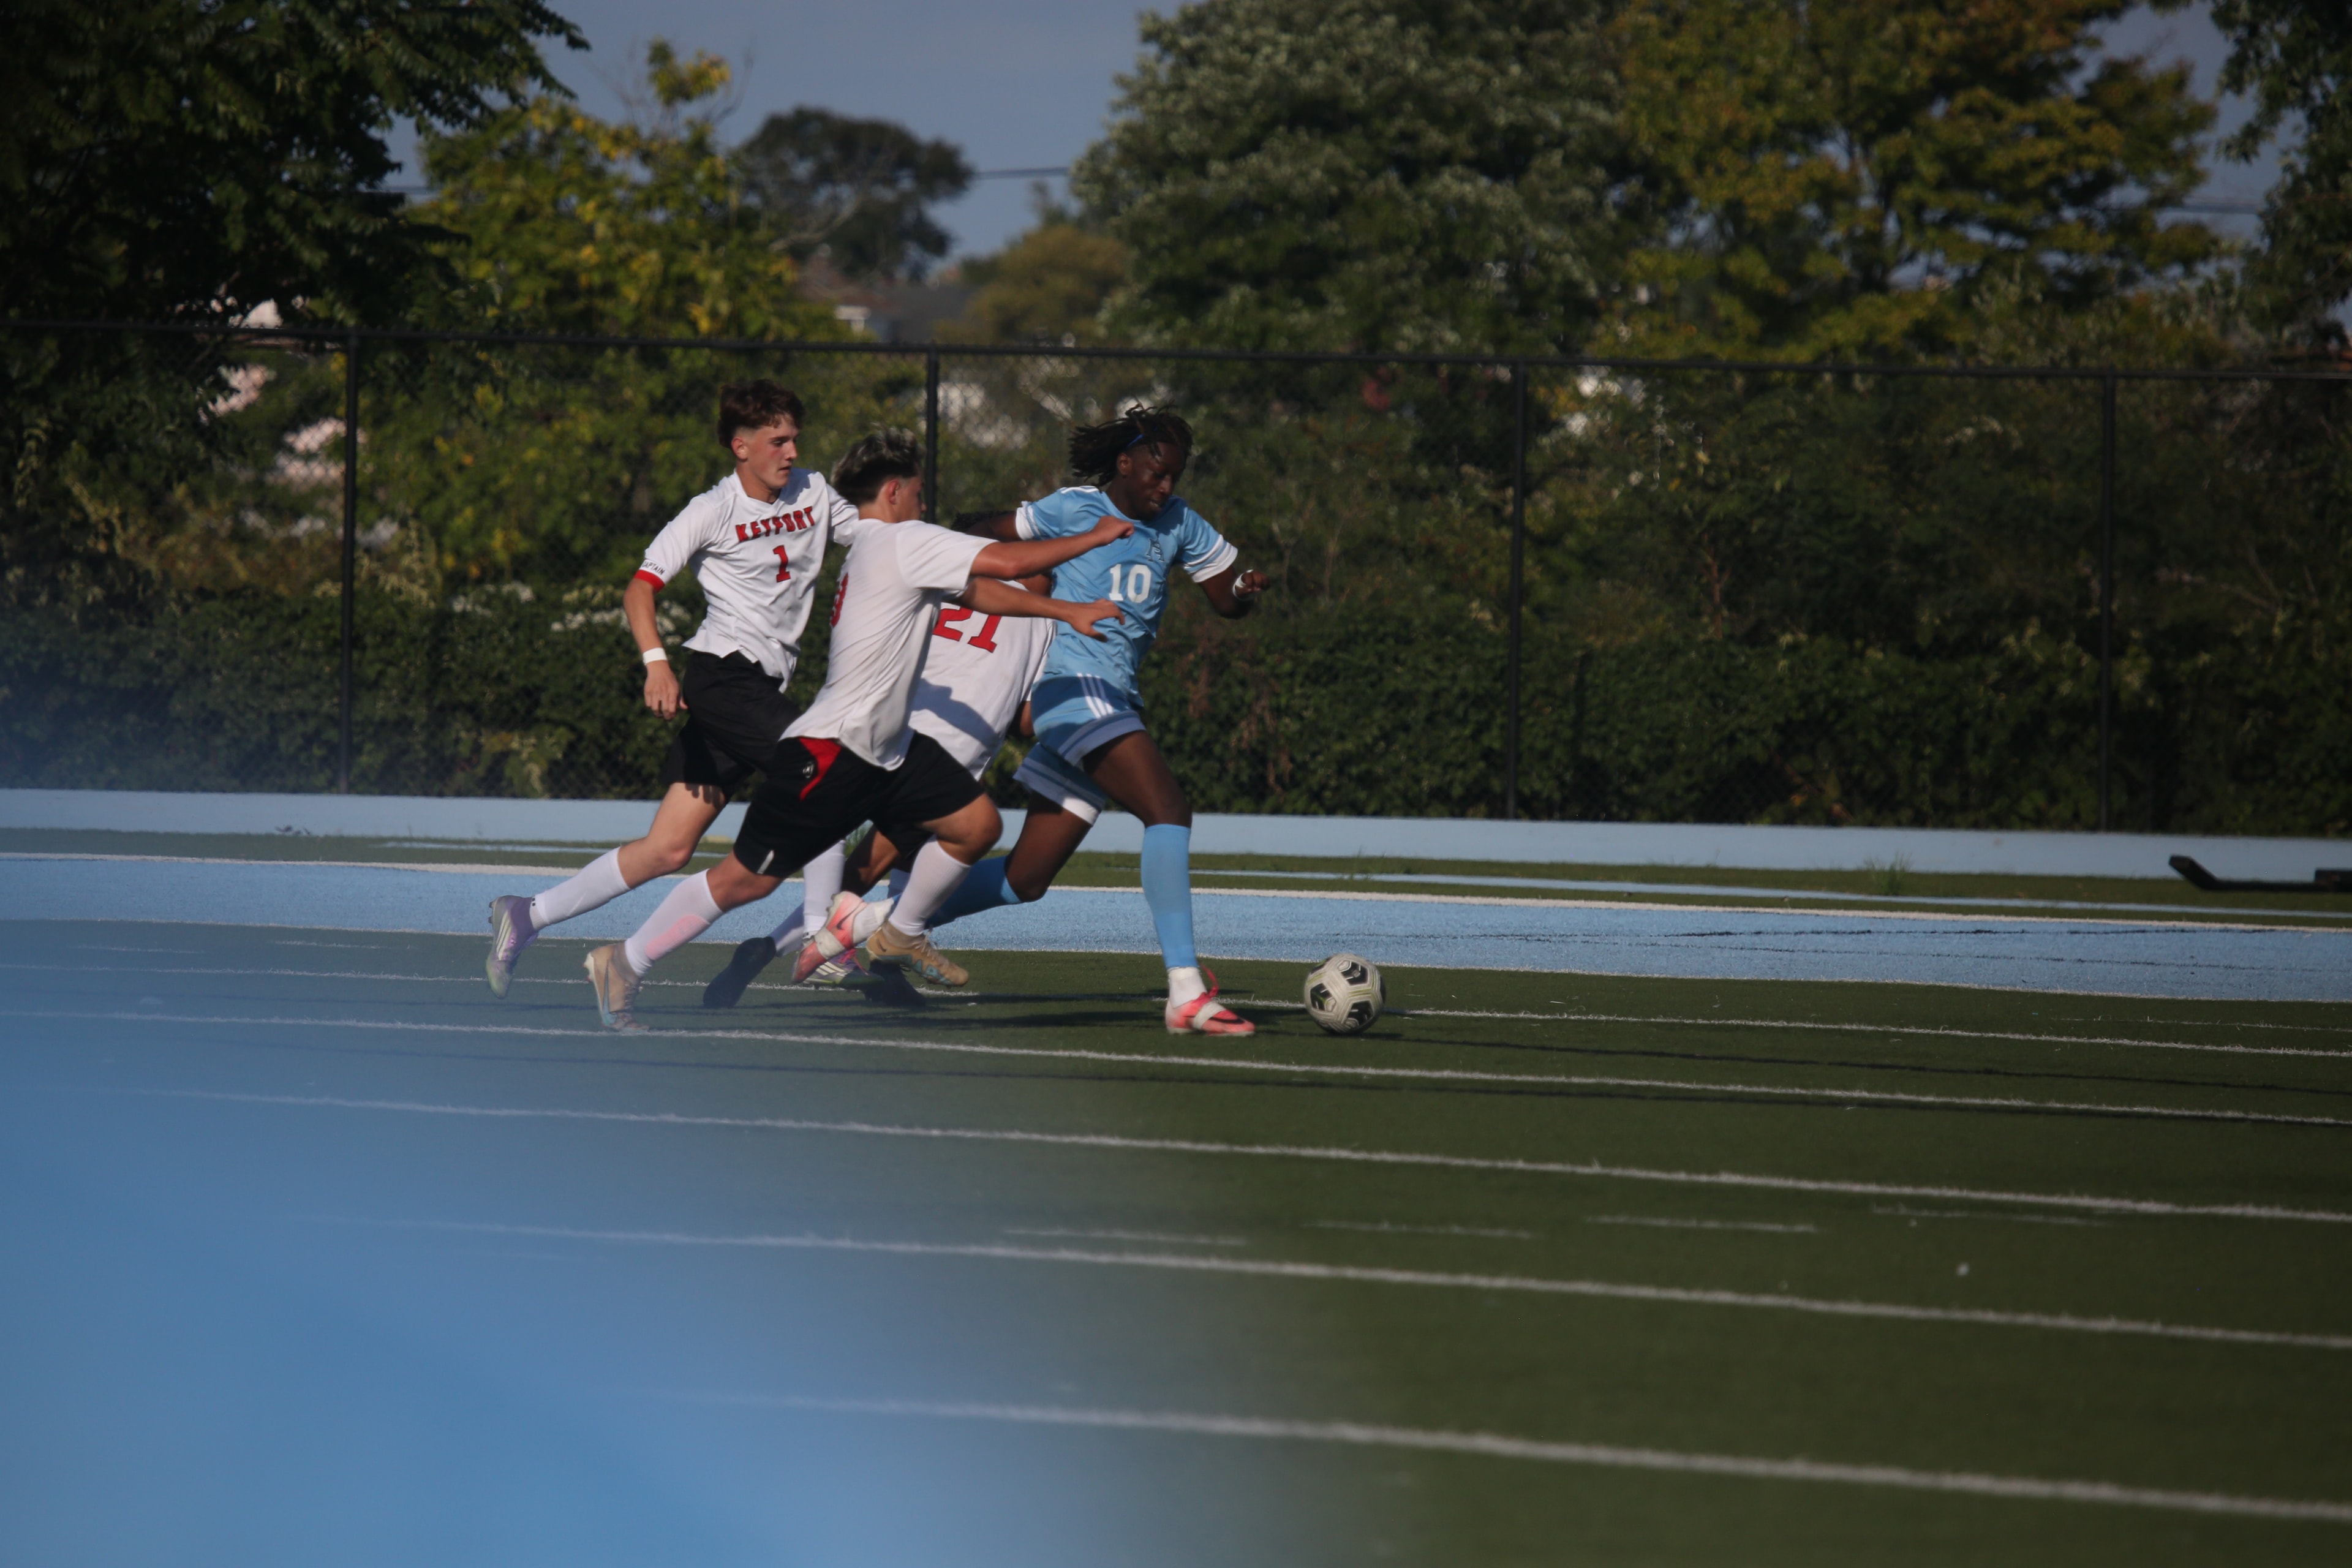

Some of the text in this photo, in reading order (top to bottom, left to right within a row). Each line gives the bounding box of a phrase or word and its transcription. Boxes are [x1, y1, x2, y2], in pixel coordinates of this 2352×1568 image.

[735, 506, 815, 543] KEYPORT
[772, 545, 791, 583] 1
[1109, 564, 1152, 603] 10
[932, 606, 1002, 654] 21
